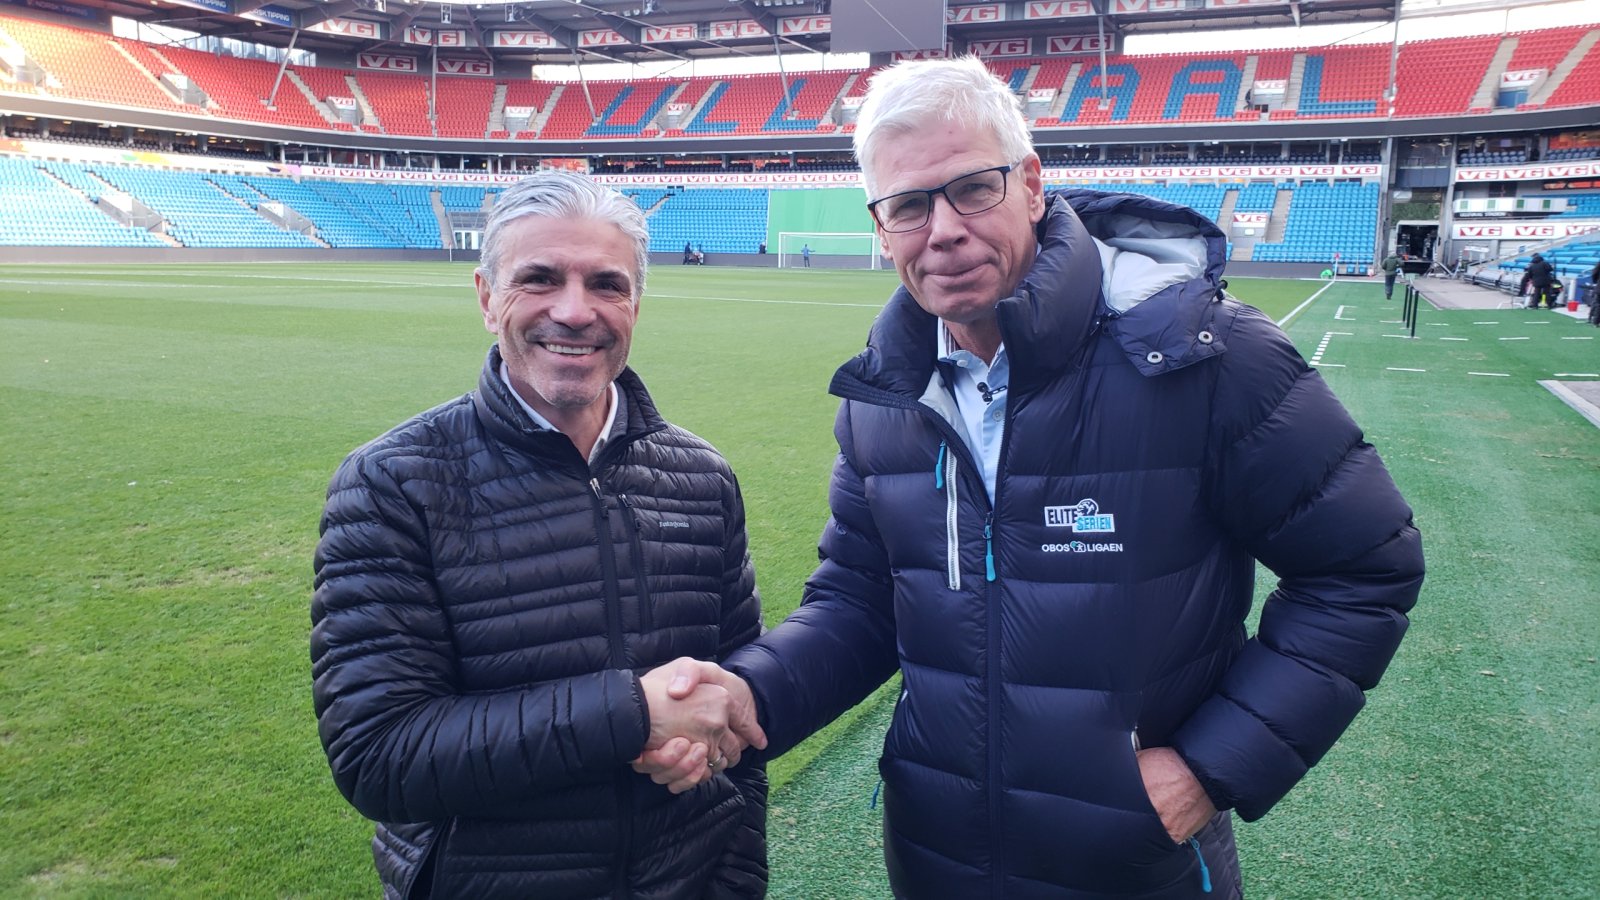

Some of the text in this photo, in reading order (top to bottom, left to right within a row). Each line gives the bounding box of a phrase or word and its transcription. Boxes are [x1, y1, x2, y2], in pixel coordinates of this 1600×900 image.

[1031, 1, 1090, 17] VG
[325, 19, 374, 36] VG
[715, 20, 764, 37] VG
[783, 17, 831, 33] VG
[410, 28, 461, 46] VG
[500, 31, 552, 46] VG
[647, 26, 693, 41] VG
[971, 42, 1027, 55] VG
[1051, 36, 1112, 53] VG
[361, 55, 413, 70] VG
[439, 60, 489, 74] VG
[687, 175, 710, 183] VG
[773, 174, 797, 182] VG
[803, 174, 827, 182] VG
[1103, 169, 1134, 177] VG
[1141, 169, 1172, 177] VG
[1179, 168, 1211, 176] VG
[1219, 168, 1250, 176] VG
[1258, 167, 1292, 175] VG
[1300, 167, 1334, 175] VG
[1342, 166, 1377, 175] VG
[1458, 170, 1499, 180] VG
[1504, 168, 1543, 178] VG
[1548, 166, 1588, 177] VG
[1234, 213, 1267, 223] VG
[1460, 227, 1502, 236] VG
[1515, 227, 1554, 236] VG
[1047, 509, 1078, 525] ELITE
[1077, 517, 1111, 531] SERIEN
[1042, 544, 1123, 552] OBOS LIGAEN
